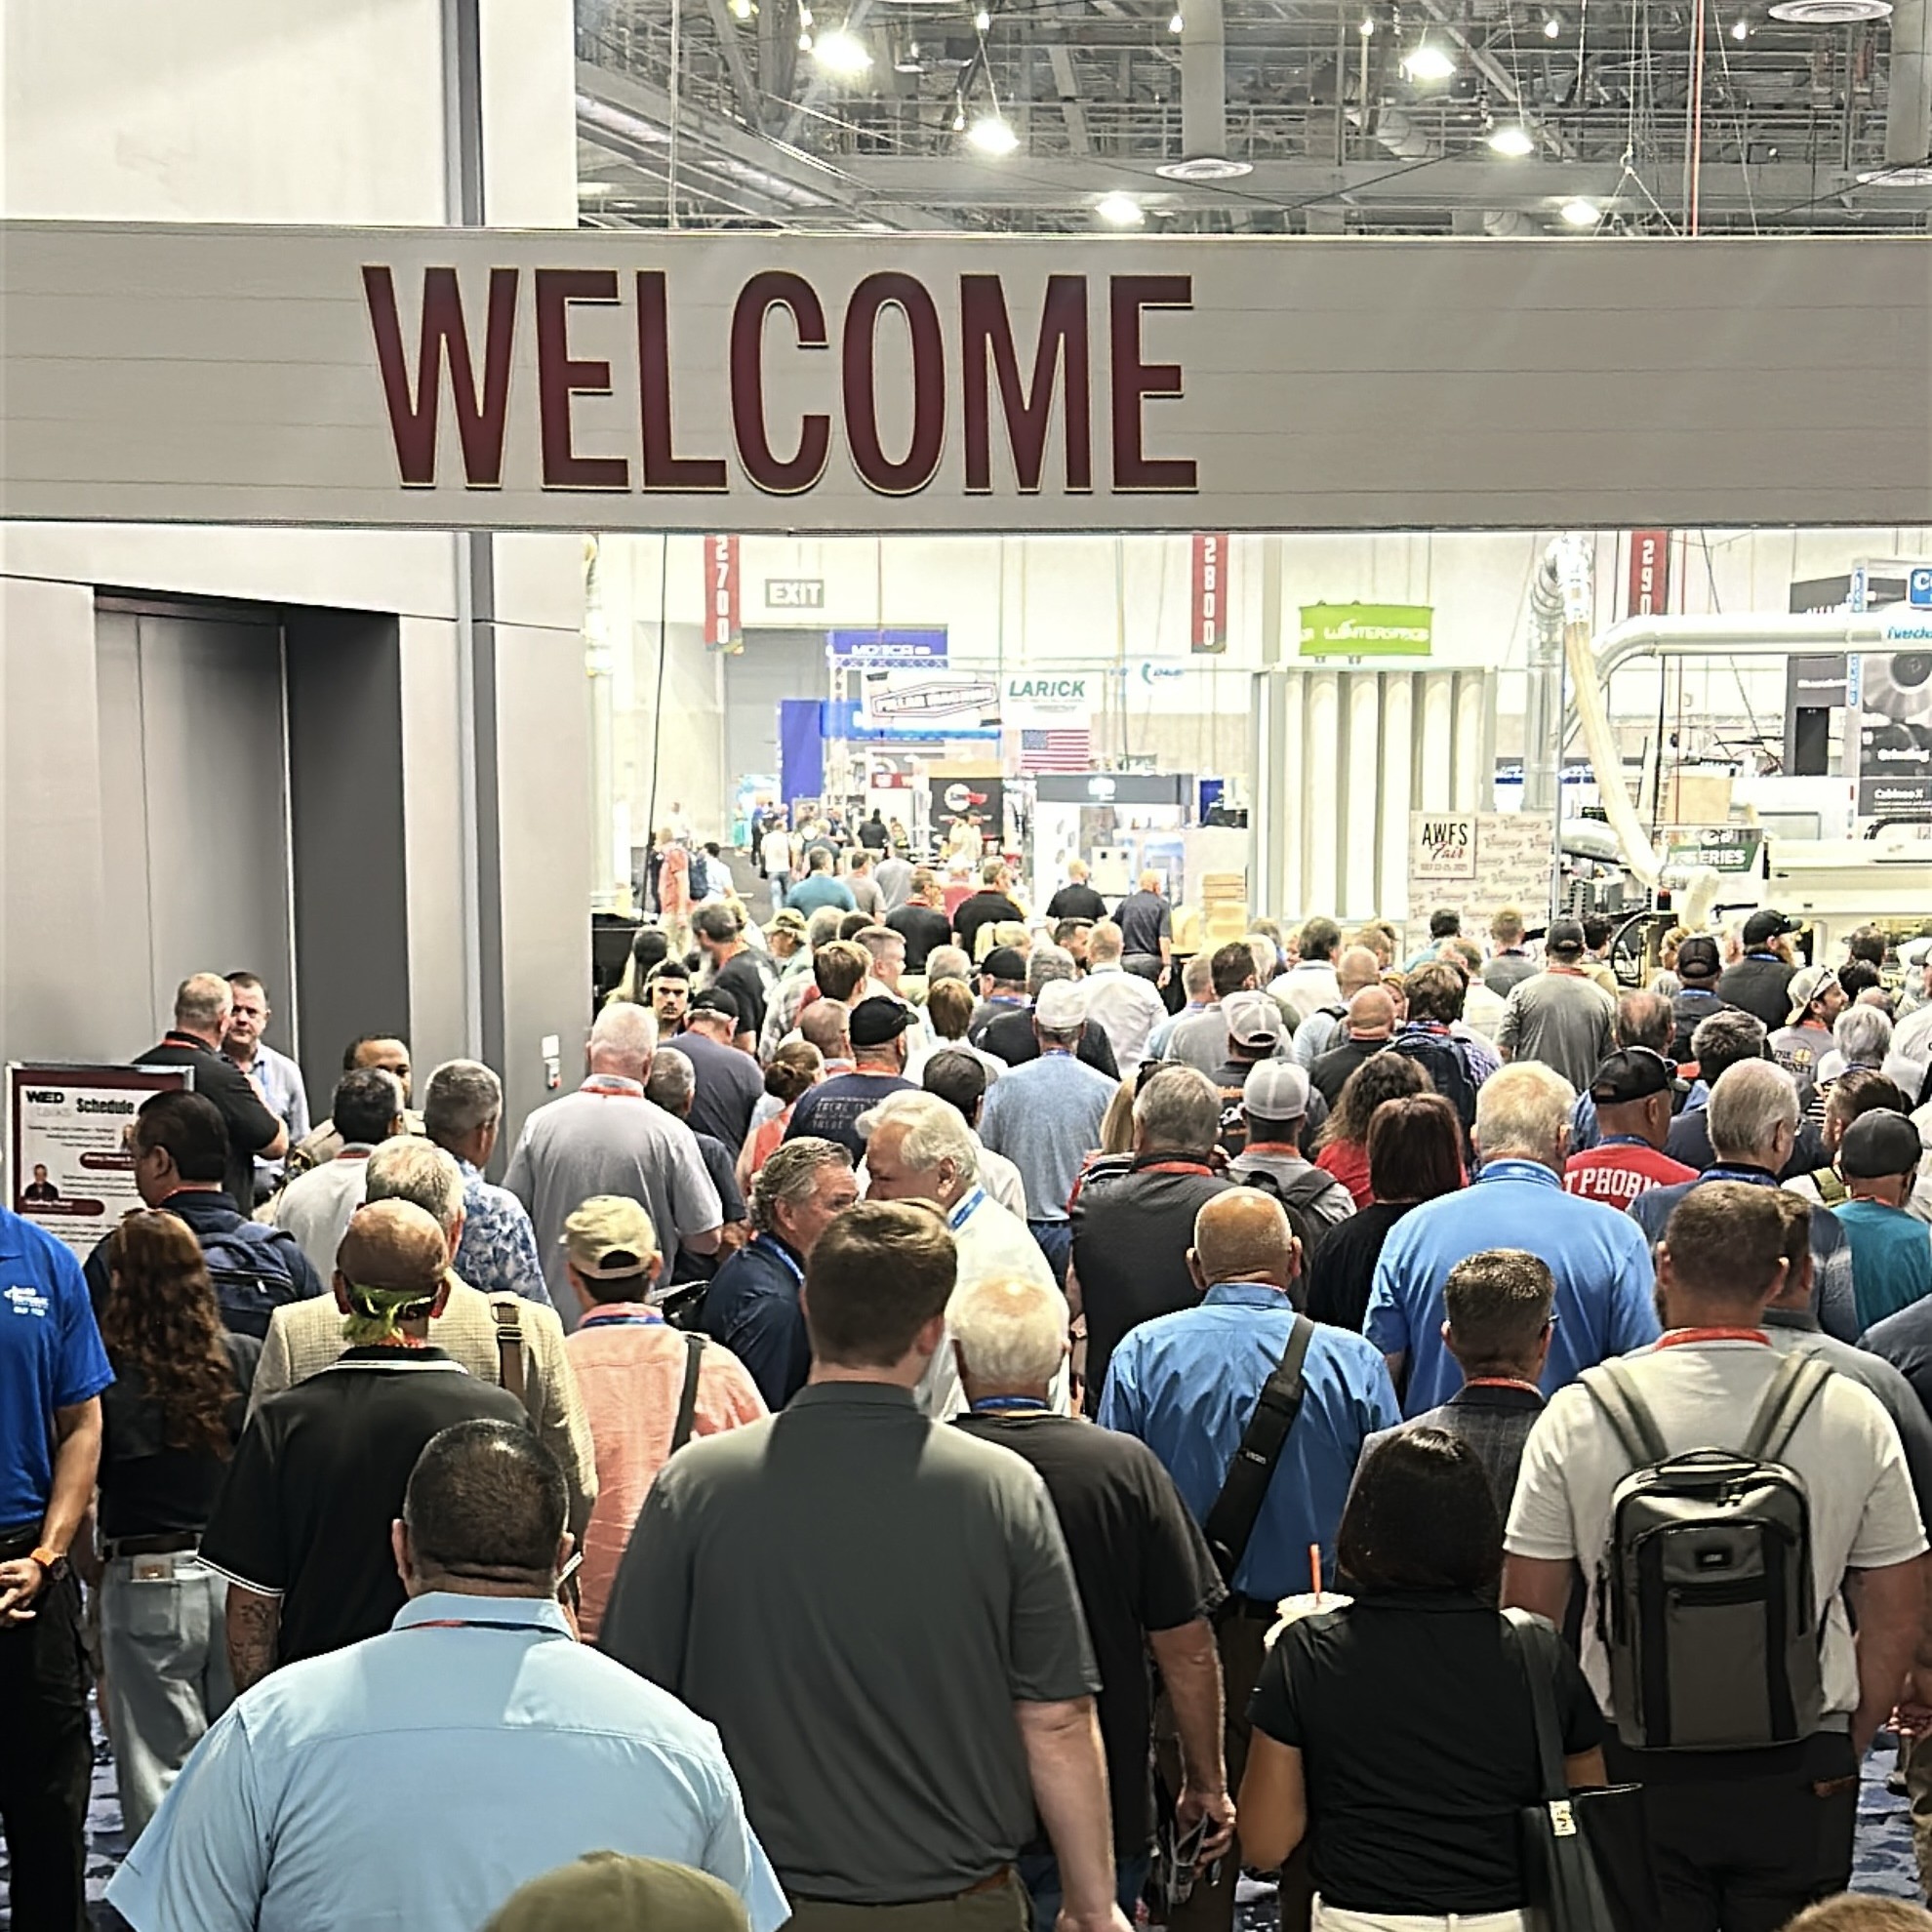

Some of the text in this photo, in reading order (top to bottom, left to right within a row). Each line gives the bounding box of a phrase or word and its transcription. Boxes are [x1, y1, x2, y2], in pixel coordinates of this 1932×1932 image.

[361, 263, 1198, 496] WELCOME
[715, 535, 730, 644] 2700
[769, 582, 822, 605] EXIT
[1202, 537, 1217, 646] 2800
[1640, 539, 1655, 616] 290
[1009, 680, 1086, 698] LARICK
[1422, 823, 1469, 846] AWFS
[25, 1090, 135, 1114] WED Schedule
